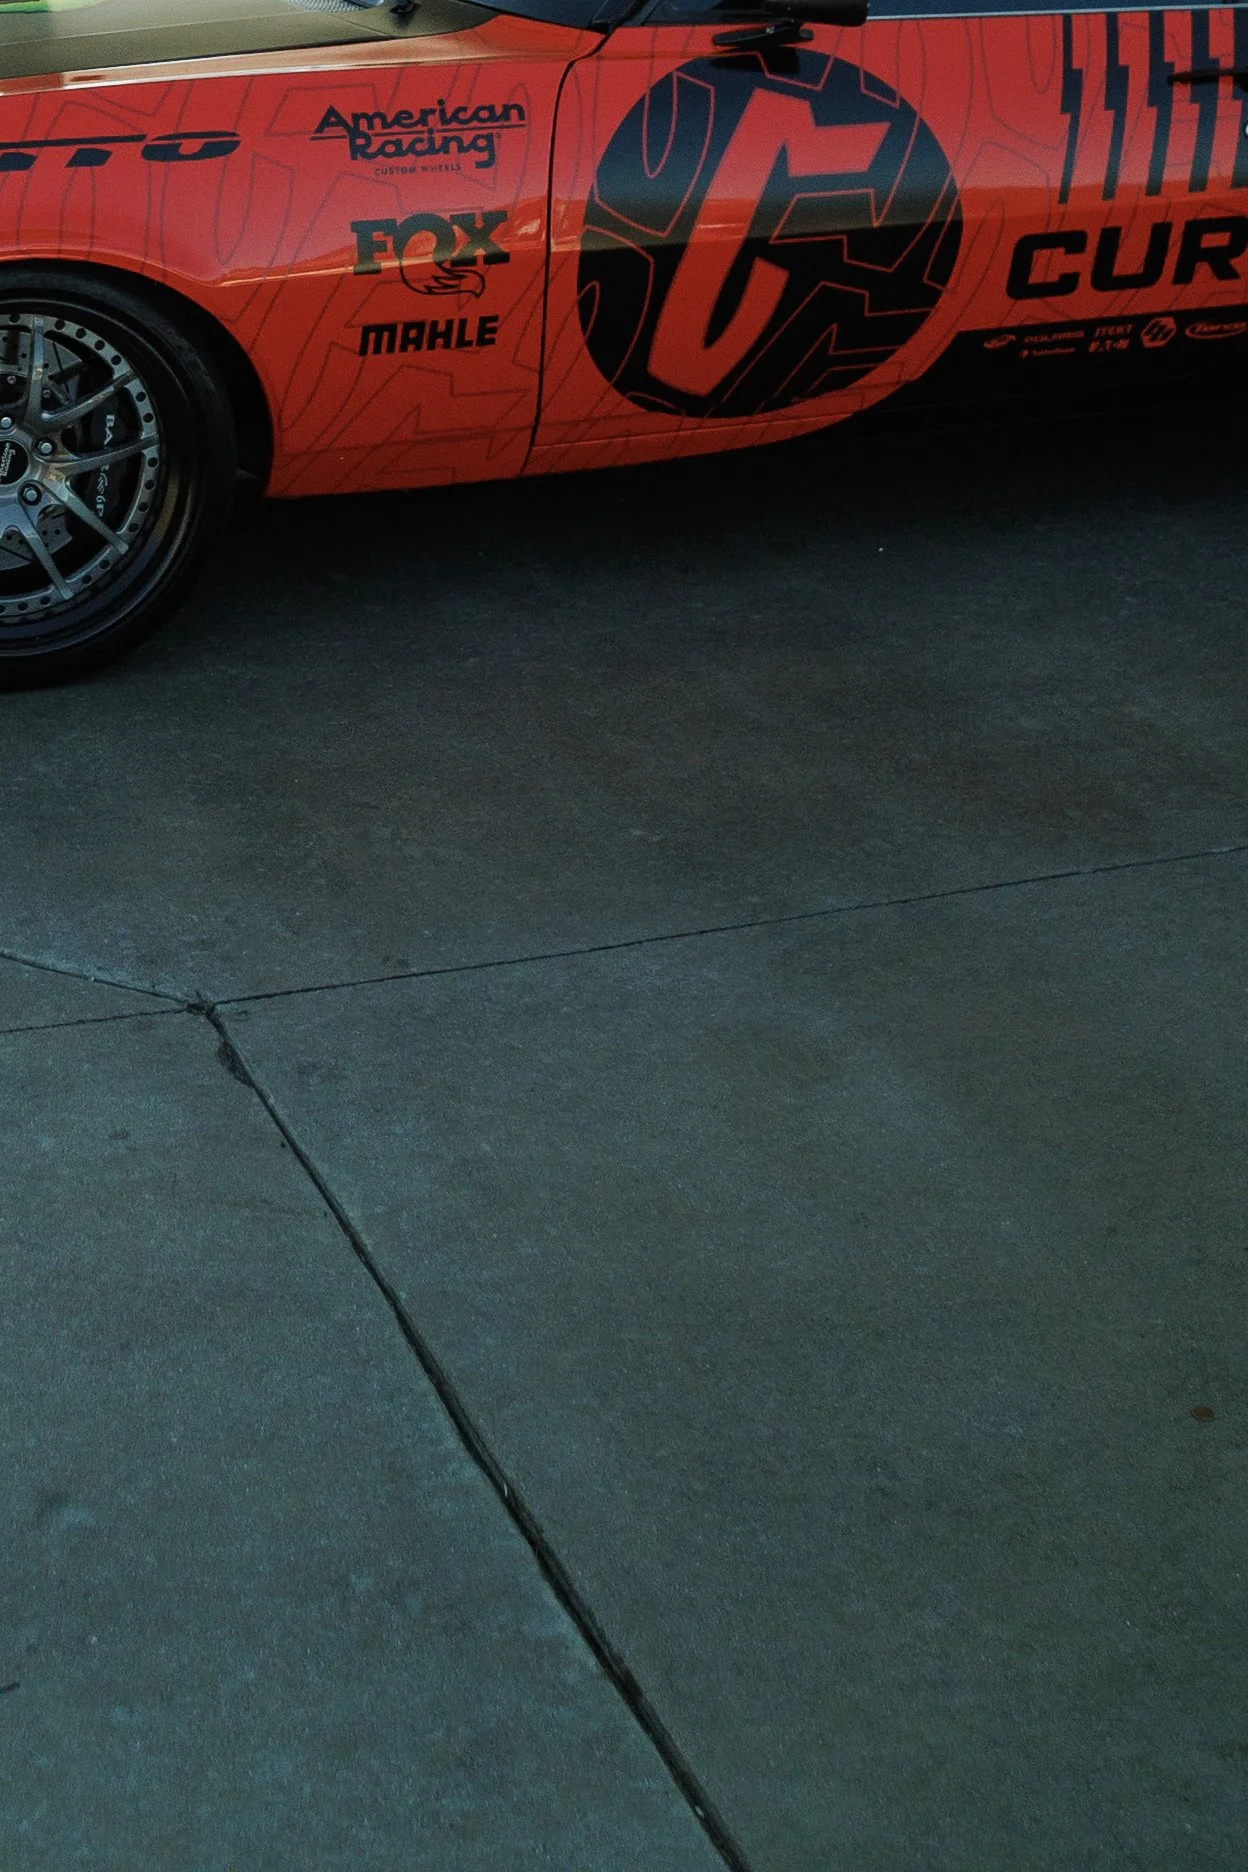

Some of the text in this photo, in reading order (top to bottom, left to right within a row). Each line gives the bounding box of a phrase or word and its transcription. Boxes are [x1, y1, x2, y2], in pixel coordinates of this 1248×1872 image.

[313, 99, 527, 134] American
[349, 128, 496, 169] Racing
[374, 163, 462, 176] CUSTOM WHEELS
[351, 210, 510, 275] FOX
[1006, 215, 1248, 300] CUR
[359, 314, 500, 357] MAHLE
